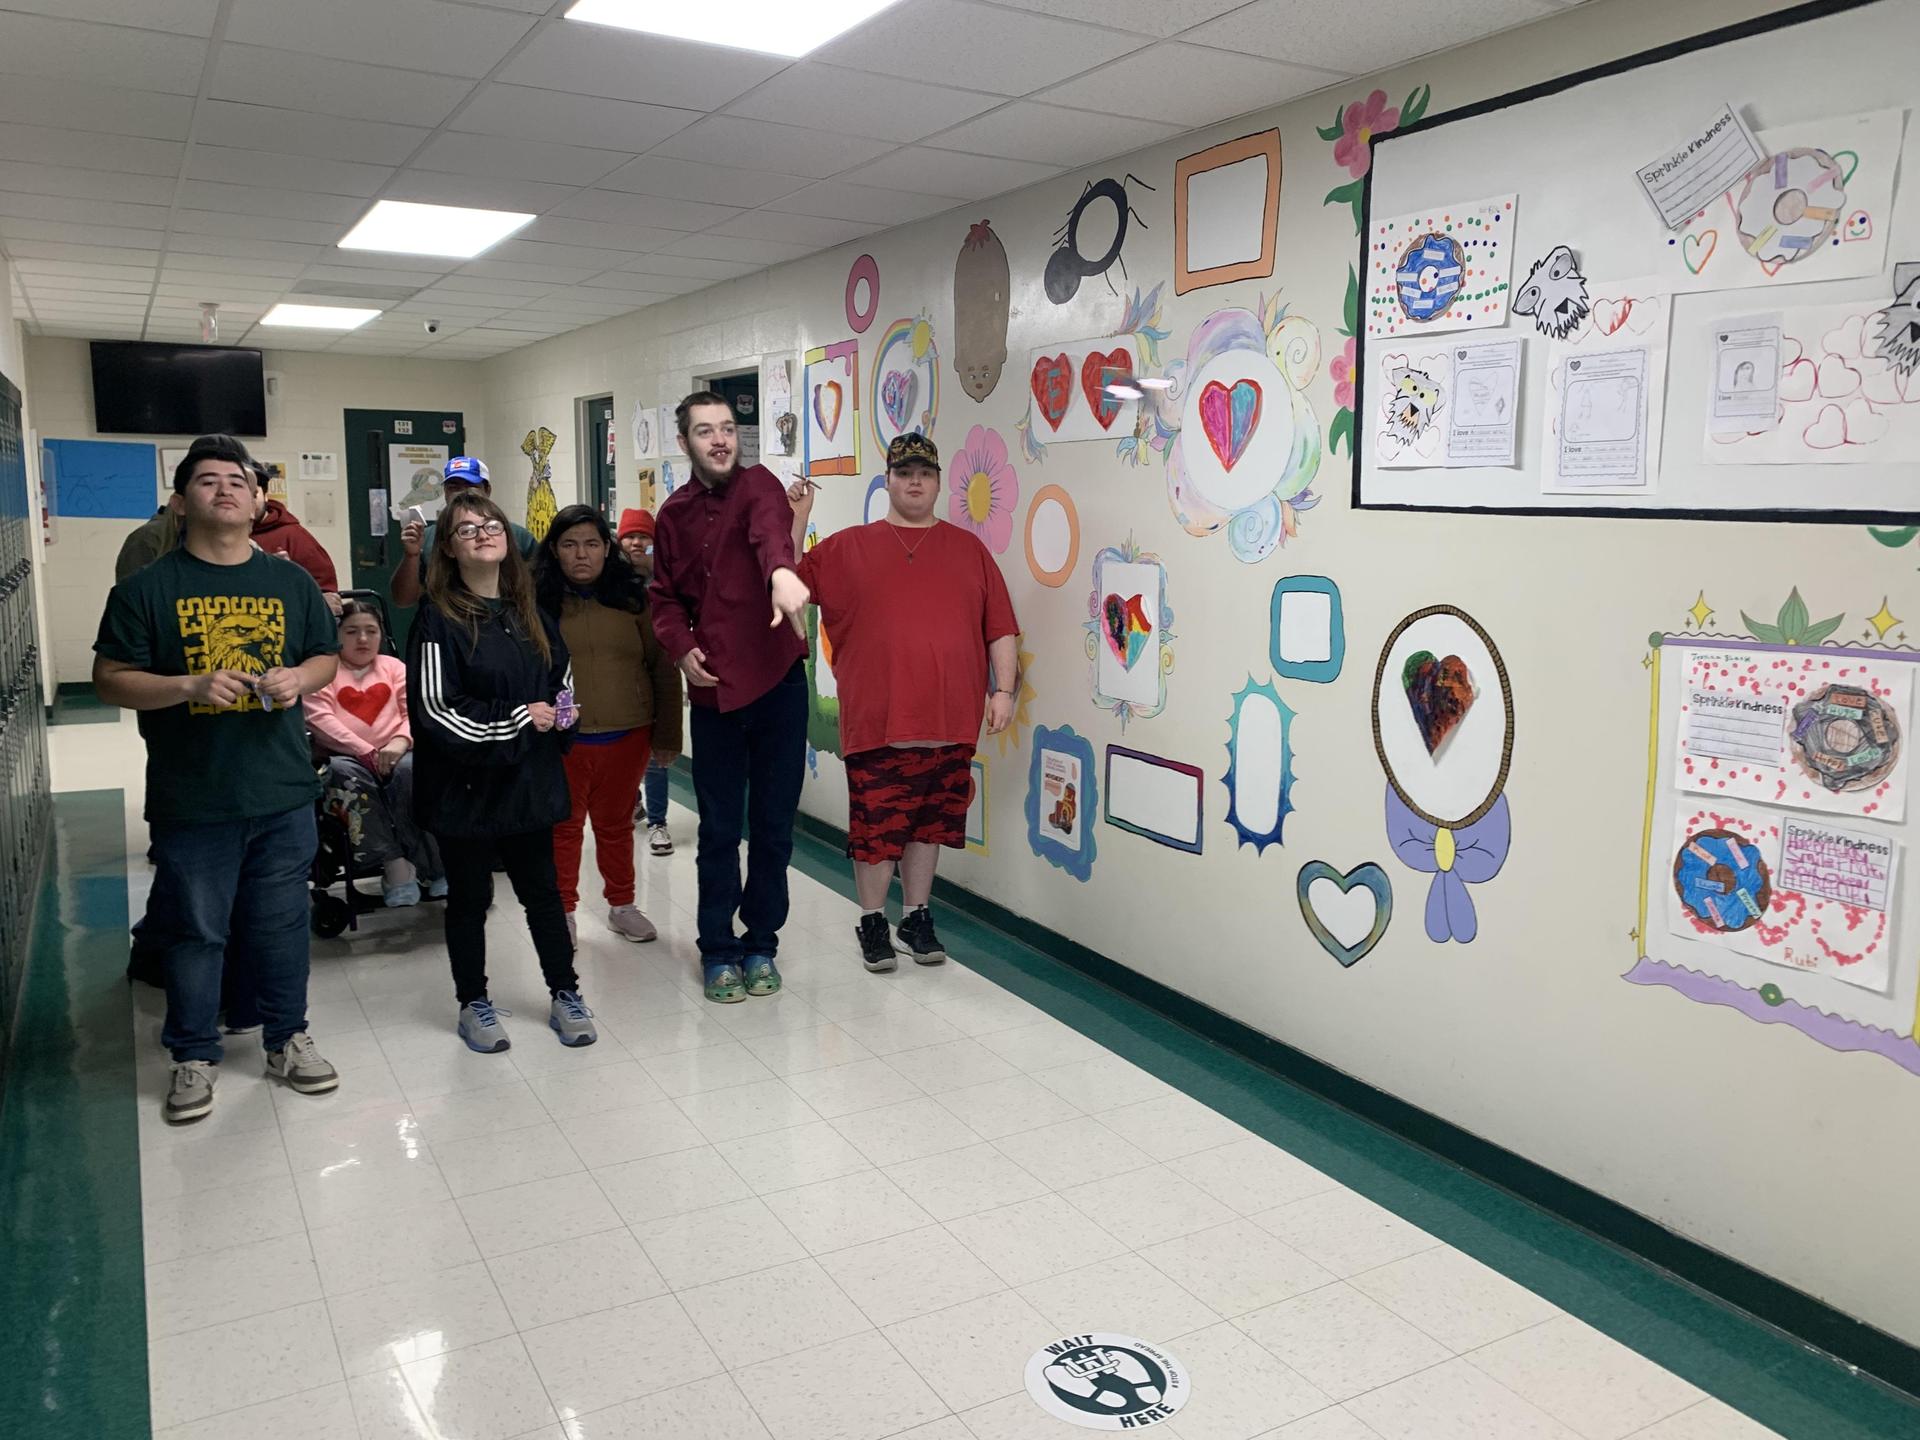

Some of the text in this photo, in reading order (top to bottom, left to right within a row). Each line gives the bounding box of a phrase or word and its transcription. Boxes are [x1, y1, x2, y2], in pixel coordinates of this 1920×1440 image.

[1644, 113, 1732, 183] Sprinkle Kindness
[176, 597, 217, 715] EGLES
[1692, 693, 1783, 714] Sprinkle Kindness
[1788, 825, 1834, 843] Sprinkle
[1836, 835, 1889, 856] Kindness
[1044, 1334, 1094, 1356] WAIT
[1119, 1403, 1175, 1428] HERE
